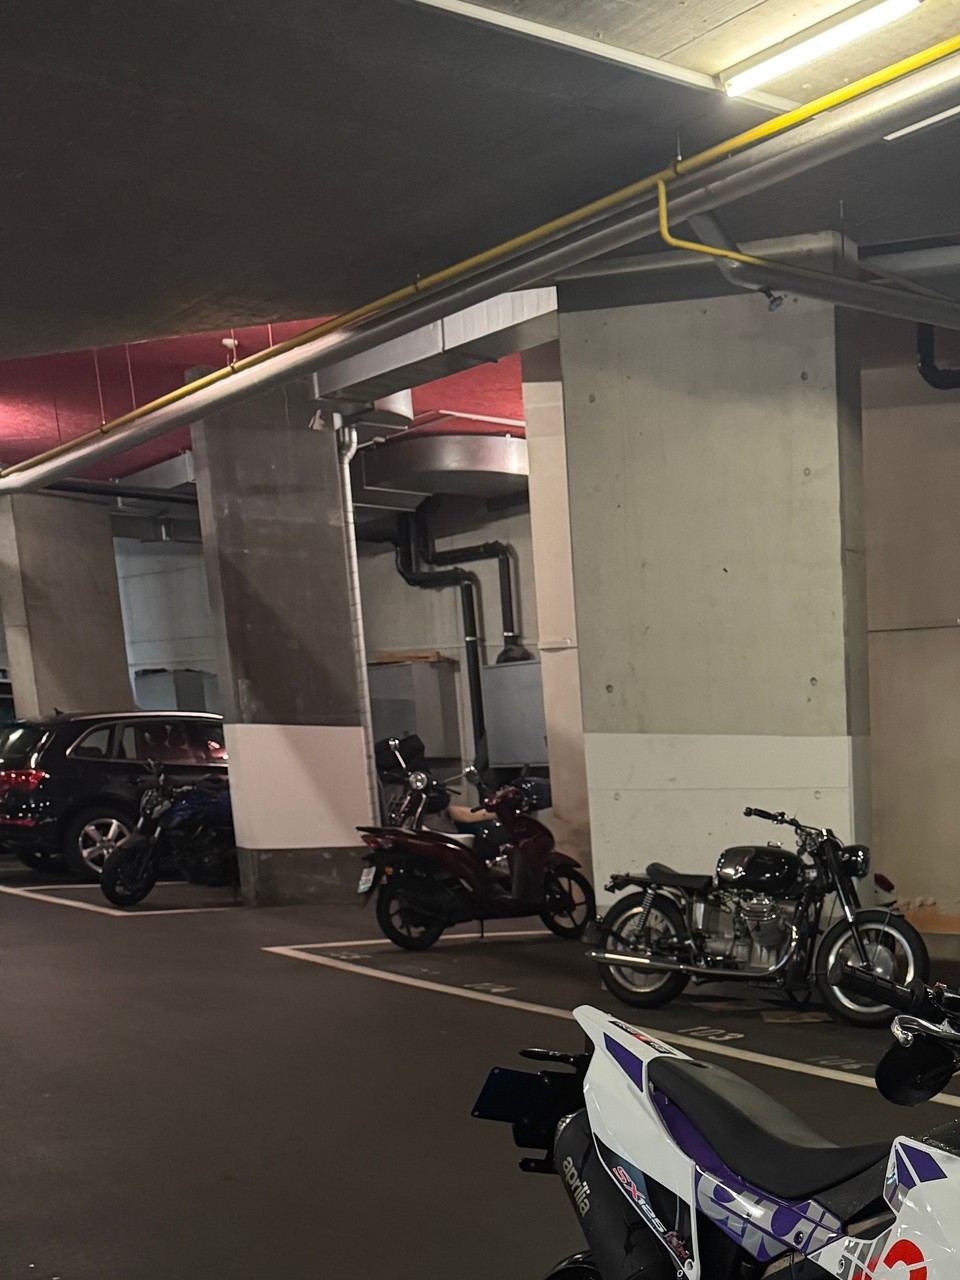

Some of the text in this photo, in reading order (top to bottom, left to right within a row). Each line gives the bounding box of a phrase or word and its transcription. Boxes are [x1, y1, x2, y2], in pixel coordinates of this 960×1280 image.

[678, 1026, 745, 1041] 103
[562, 1156, 591, 1218] aprilia
[612, 1165, 667, 1232] SX125
